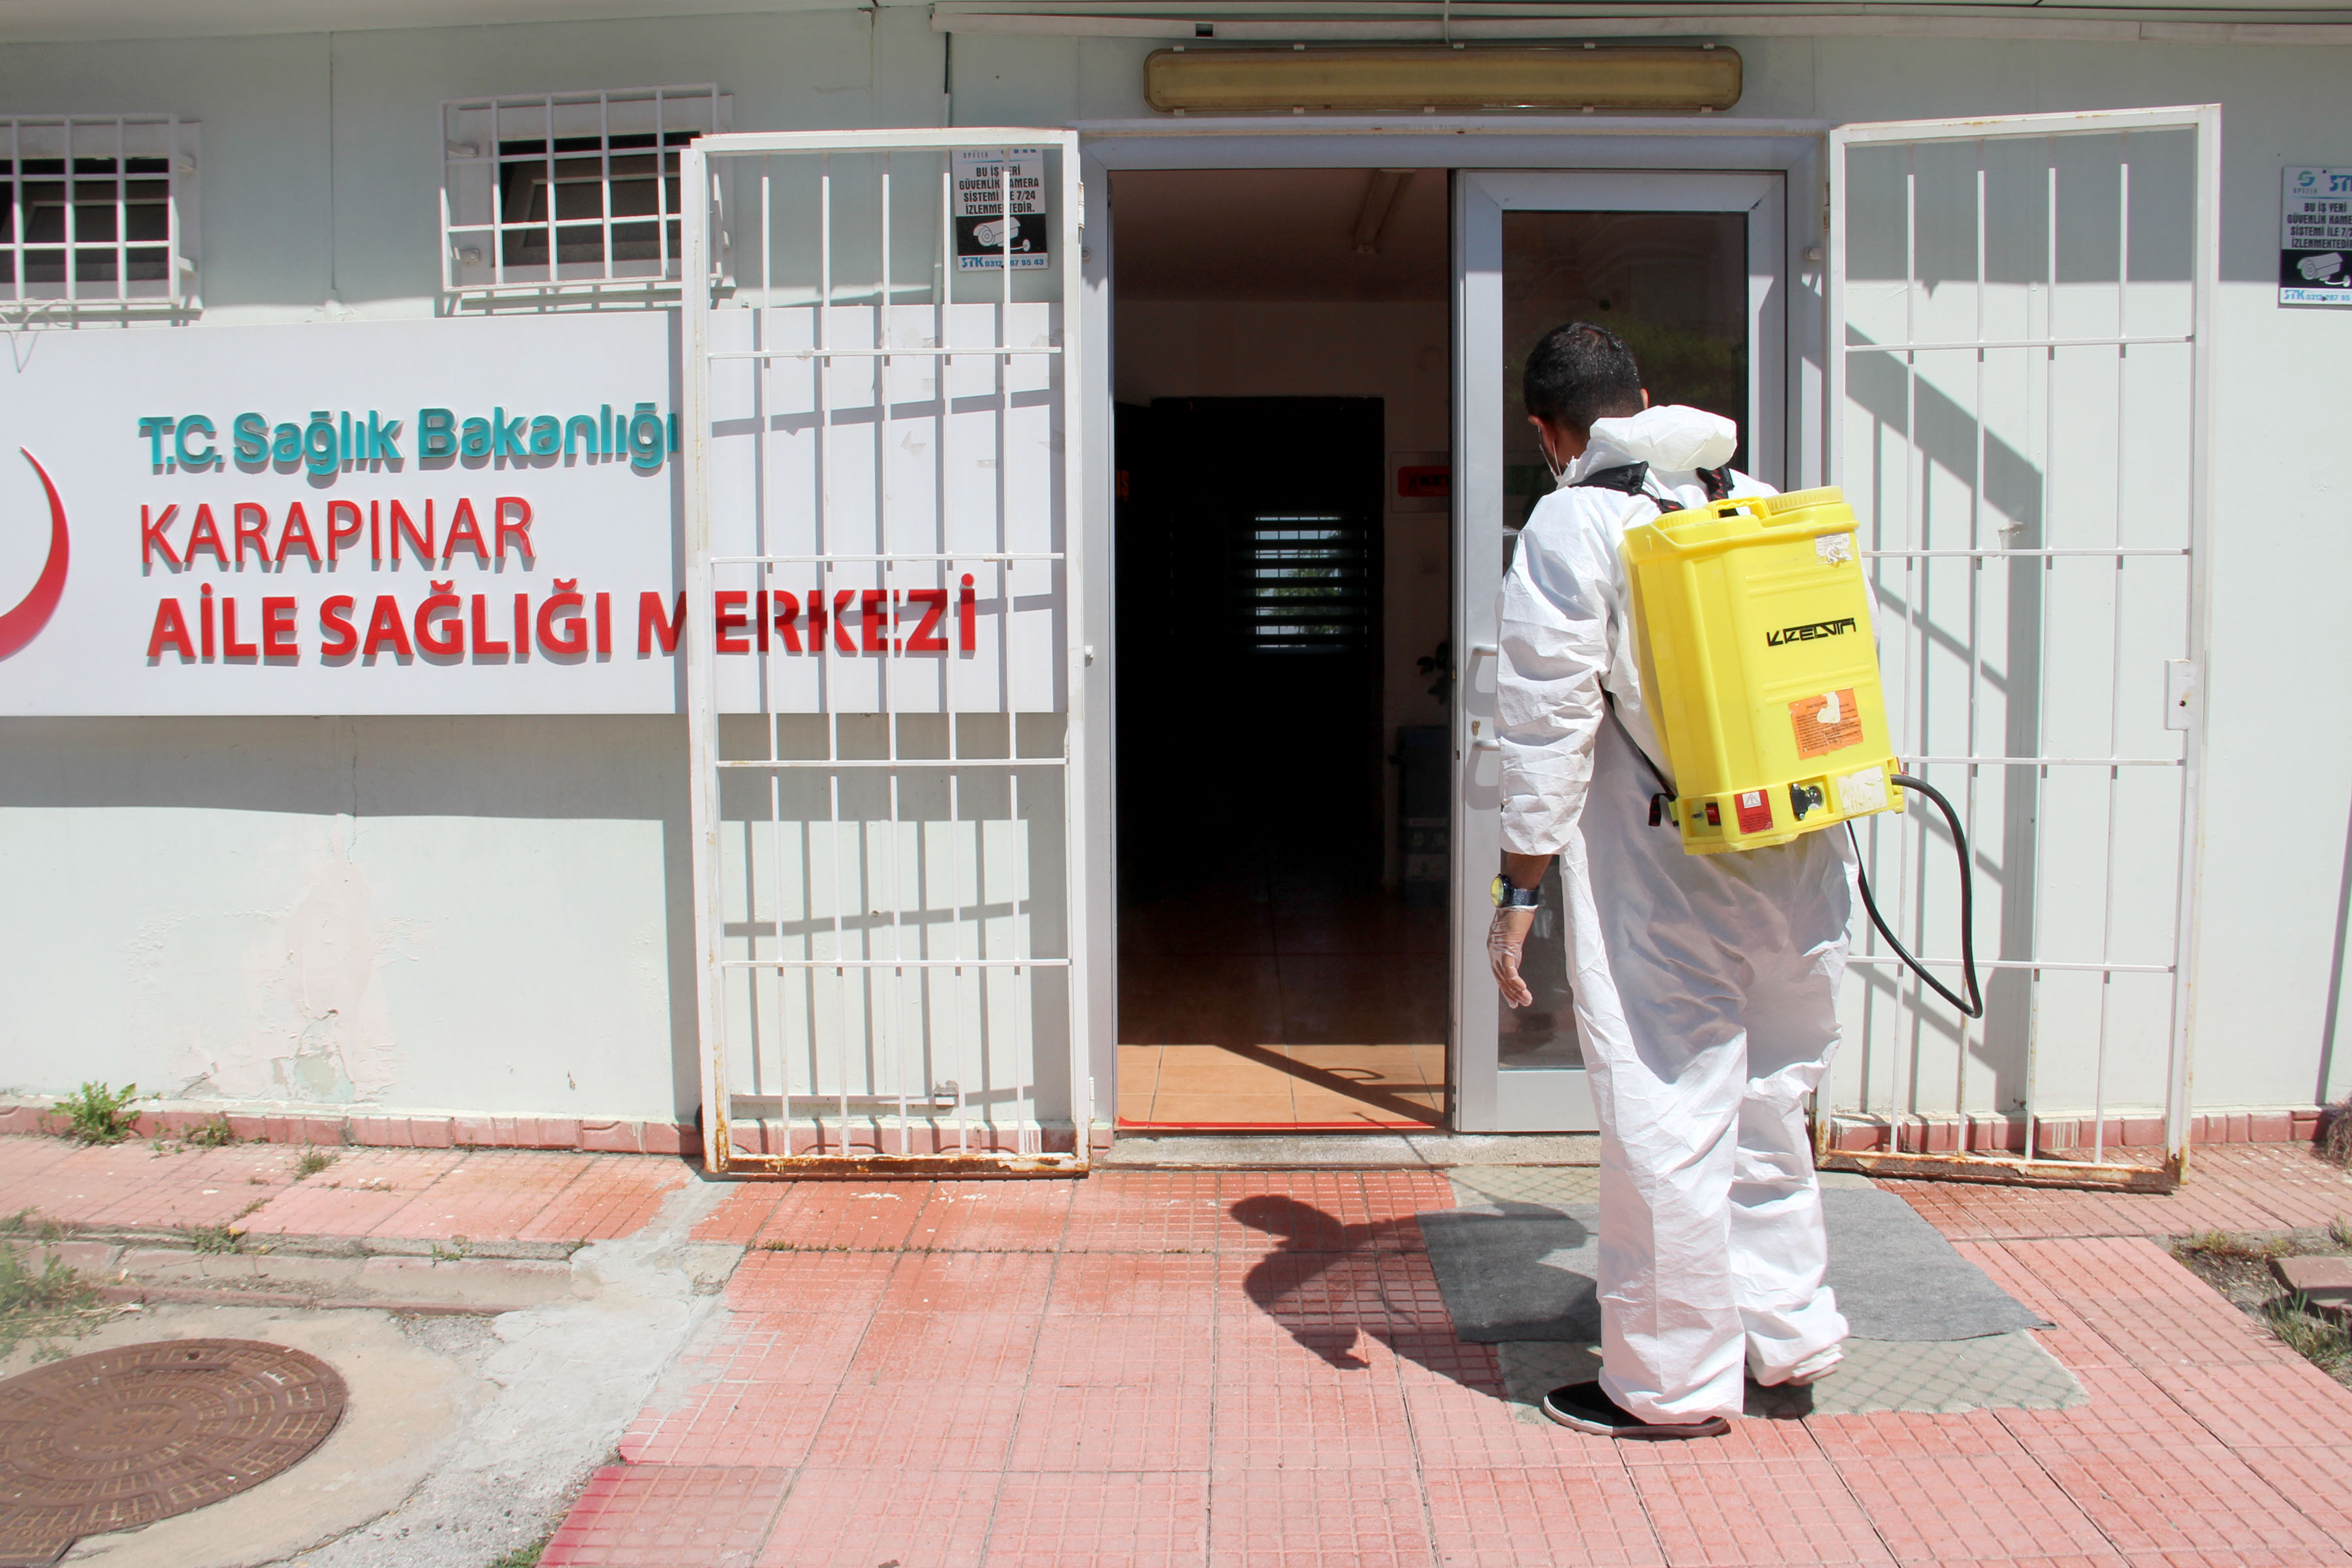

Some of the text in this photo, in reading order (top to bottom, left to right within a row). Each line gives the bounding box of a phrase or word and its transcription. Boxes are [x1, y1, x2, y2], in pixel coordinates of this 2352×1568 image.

[976, 164, 1021, 178] BU İŞ ERİ
[959, 178, 1039, 191] GÜVENLİK AMERA
[2329, 175, 2352, 192] ST
[964, 190, 999, 202] SİSTEMİ
[1017, 191, 1036, 201] 7/24
[966, 201, 1035, 215] İZLENMETEDİR.
[2304, 201, 2347, 213] BU İŞ YERİ
[2287, 212, 2326, 224] GÜVENLİK
[2291, 225, 2325, 236] SİSTEMİ
[2327, 225, 2339, 236] İLE
[138, 402, 680, 478] T.C. Sağlık Bakanlığı
[141, 497, 535, 564] KARAPINAR
[147, 573, 976, 659] AİLE SAĞLIĞI MERKEZİ
